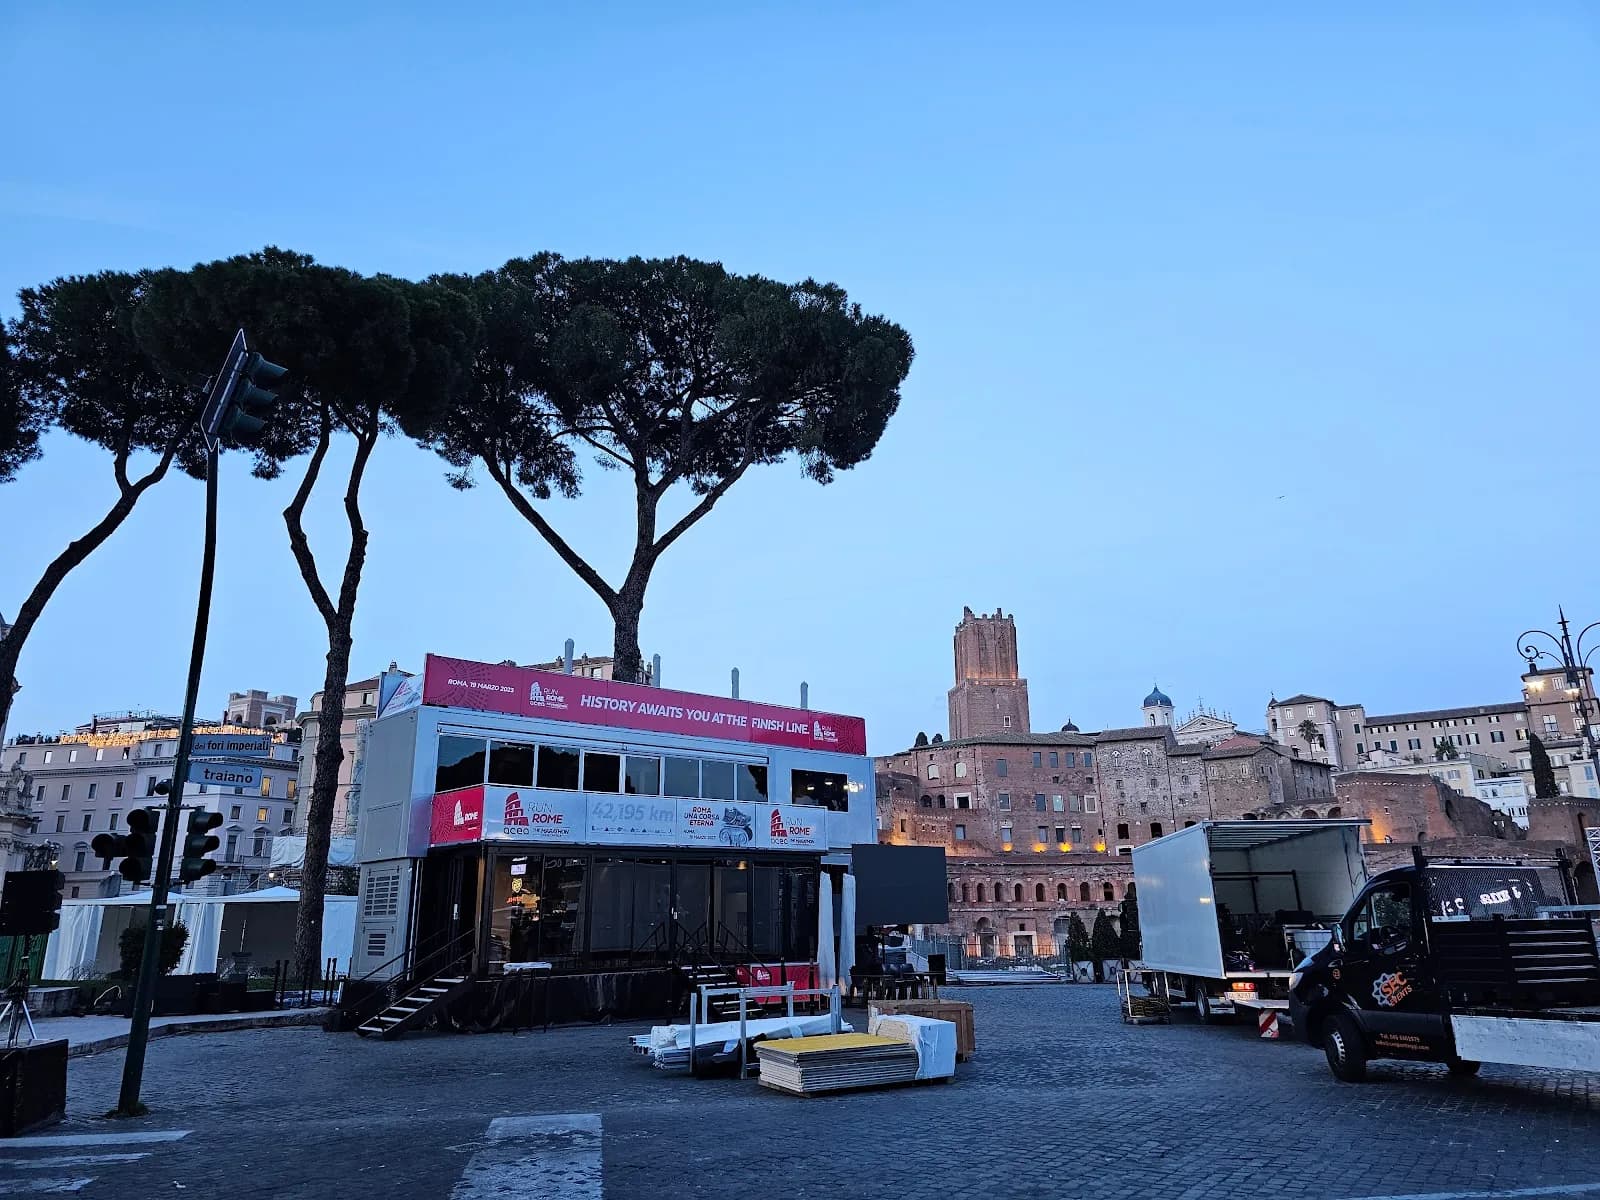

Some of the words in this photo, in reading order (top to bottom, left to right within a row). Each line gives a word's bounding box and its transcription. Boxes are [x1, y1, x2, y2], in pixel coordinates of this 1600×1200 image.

[448, 679, 468, 688] ROMA,
[477, 682, 500, 691] MARZO
[544, 687, 559, 695] RUN
[580, 694, 637, 713] HISTORY
[637, 702, 683, 719] AWAITS
[686, 708, 711, 722] YOU
[712, 712, 726, 725] AT
[725, 714, 748, 727] THE
[751, 717, 785, 731] FINISH
[786, 722, 810, 735] LINE.
[207, 740, 224, 750] fori
[226, 740, 269, 752] imperiali
[204, 768, 253, 783] traiano
[528, 801, 553, 813] RUN
[591, 801, 646, 822] 42,195
[649, 804, 674, 821] km
[692, 806, 712, 814] ROMA
[465, 811, 479, 821] ROME
[532, 813, 563, 824] ROME
[684, 812, 698, 820] UNA
[699, 813, 720, 821] CORSA
[503, 827, 529, 835] acea
[789, 826, 811, 836] ROME
